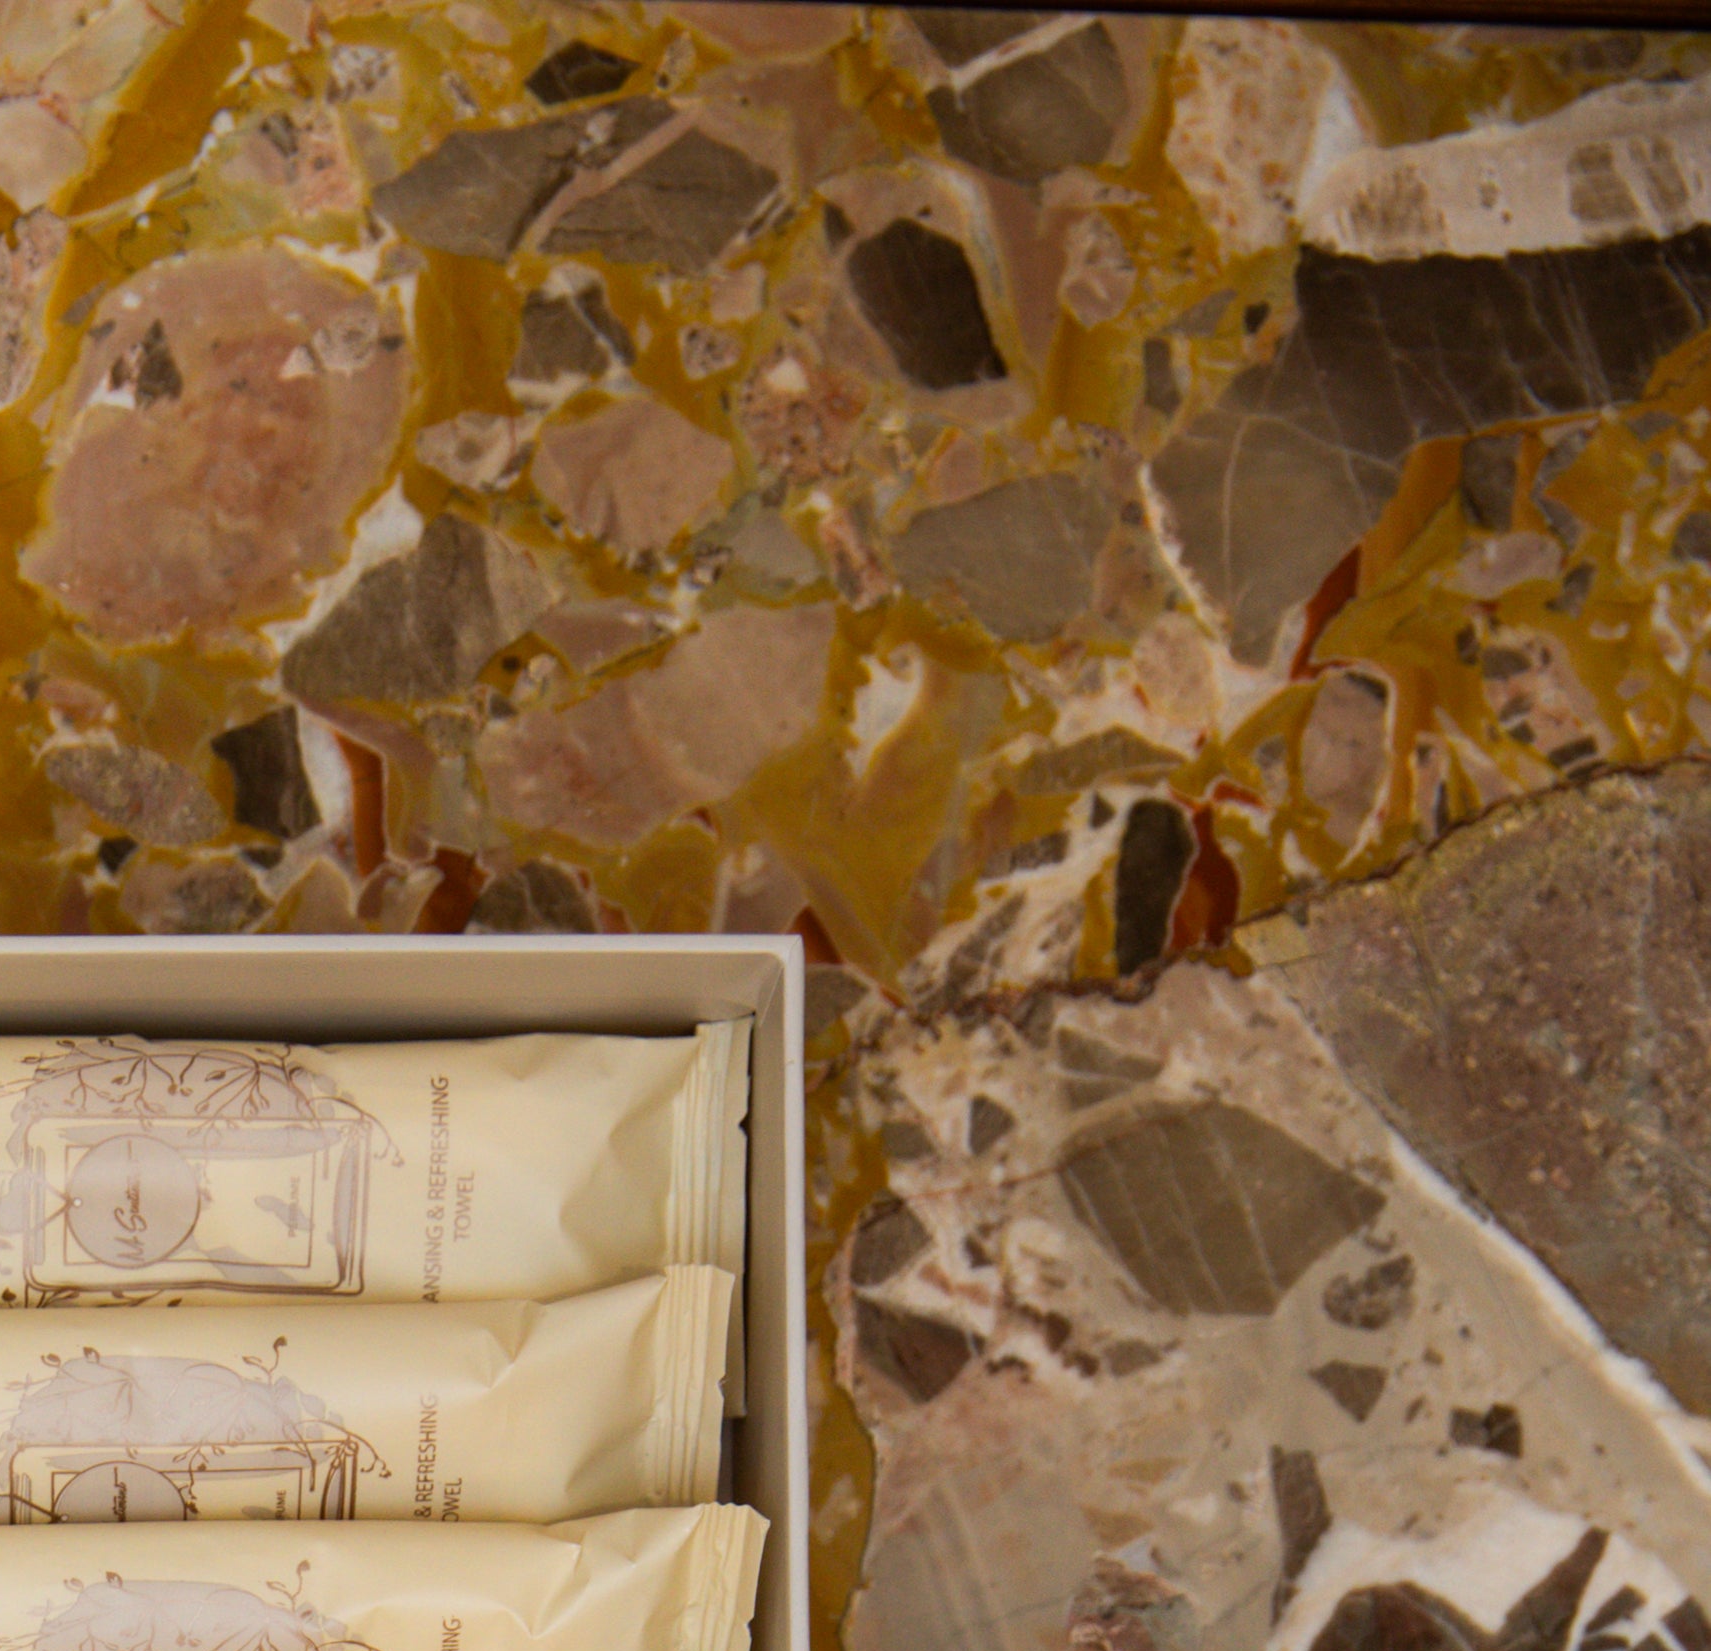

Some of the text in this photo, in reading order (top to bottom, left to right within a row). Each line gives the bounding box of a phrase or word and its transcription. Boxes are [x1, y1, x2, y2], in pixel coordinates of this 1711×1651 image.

[422, 1076, 450, 1304] ANSING & REFRESHING
[453, 1171, 474, 1242] TOWEL
[413, 1394, 438, 1518] & REFRESHING
[442, 1477, 462, 1522] OWEL
